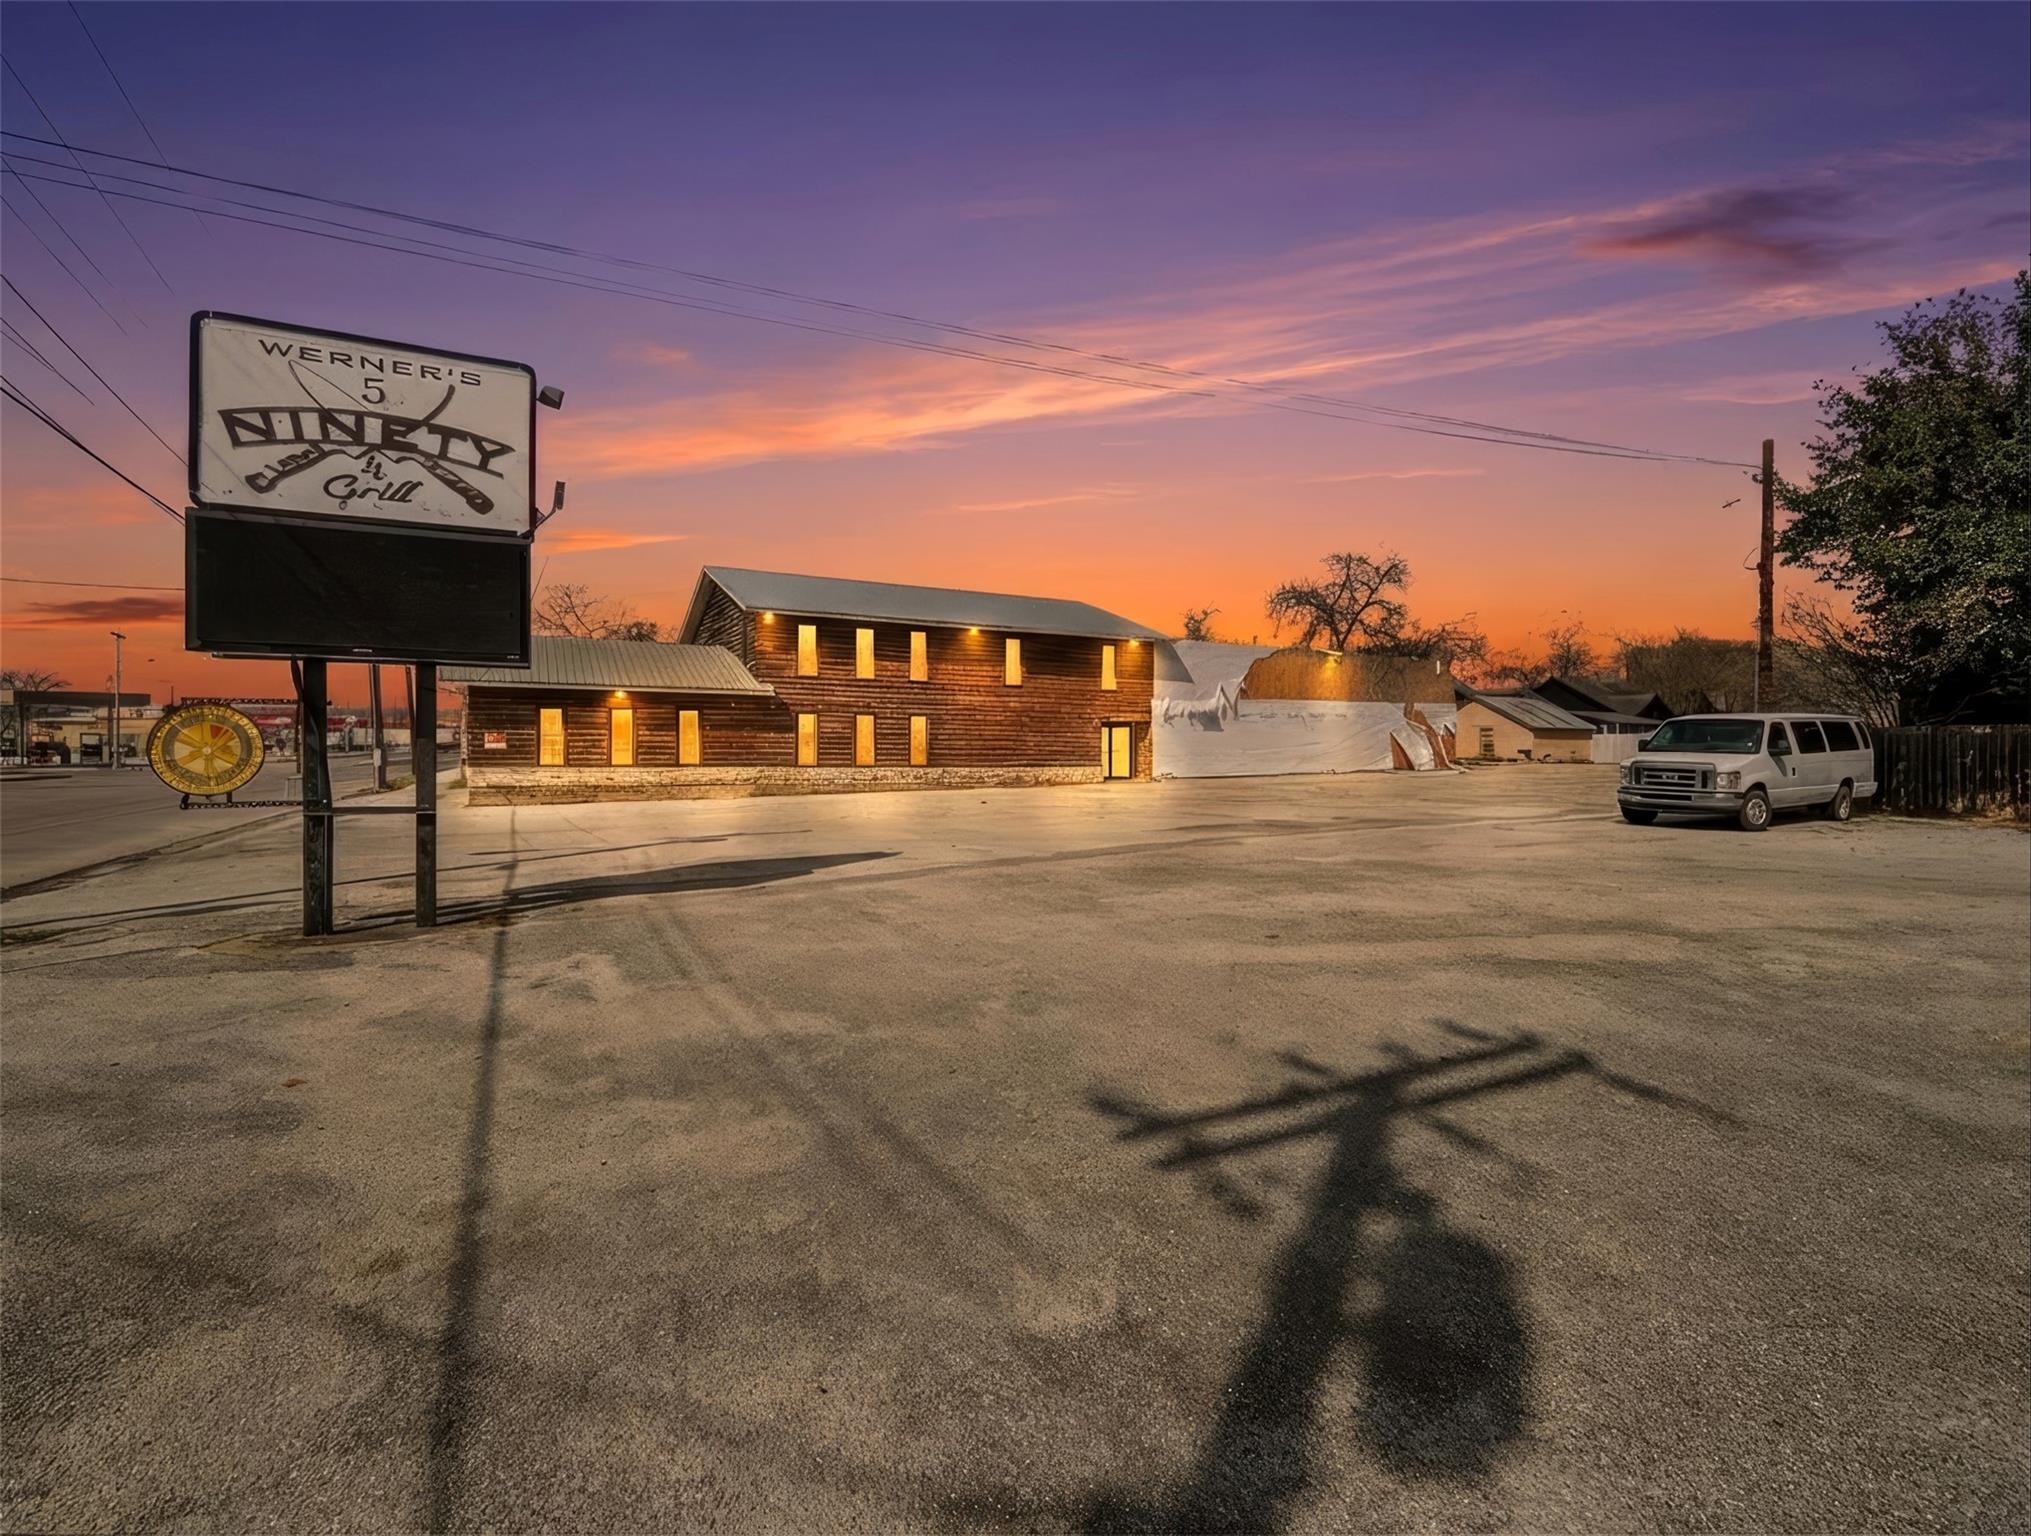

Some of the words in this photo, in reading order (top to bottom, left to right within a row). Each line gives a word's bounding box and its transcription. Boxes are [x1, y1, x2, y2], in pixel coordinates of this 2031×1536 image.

[258, 339, 481, 386] WERNER'S
[361, 377, 386, 404] 5
[217, 406, 516, 480] NINETY
[323, 474, 424, 503] Grill
